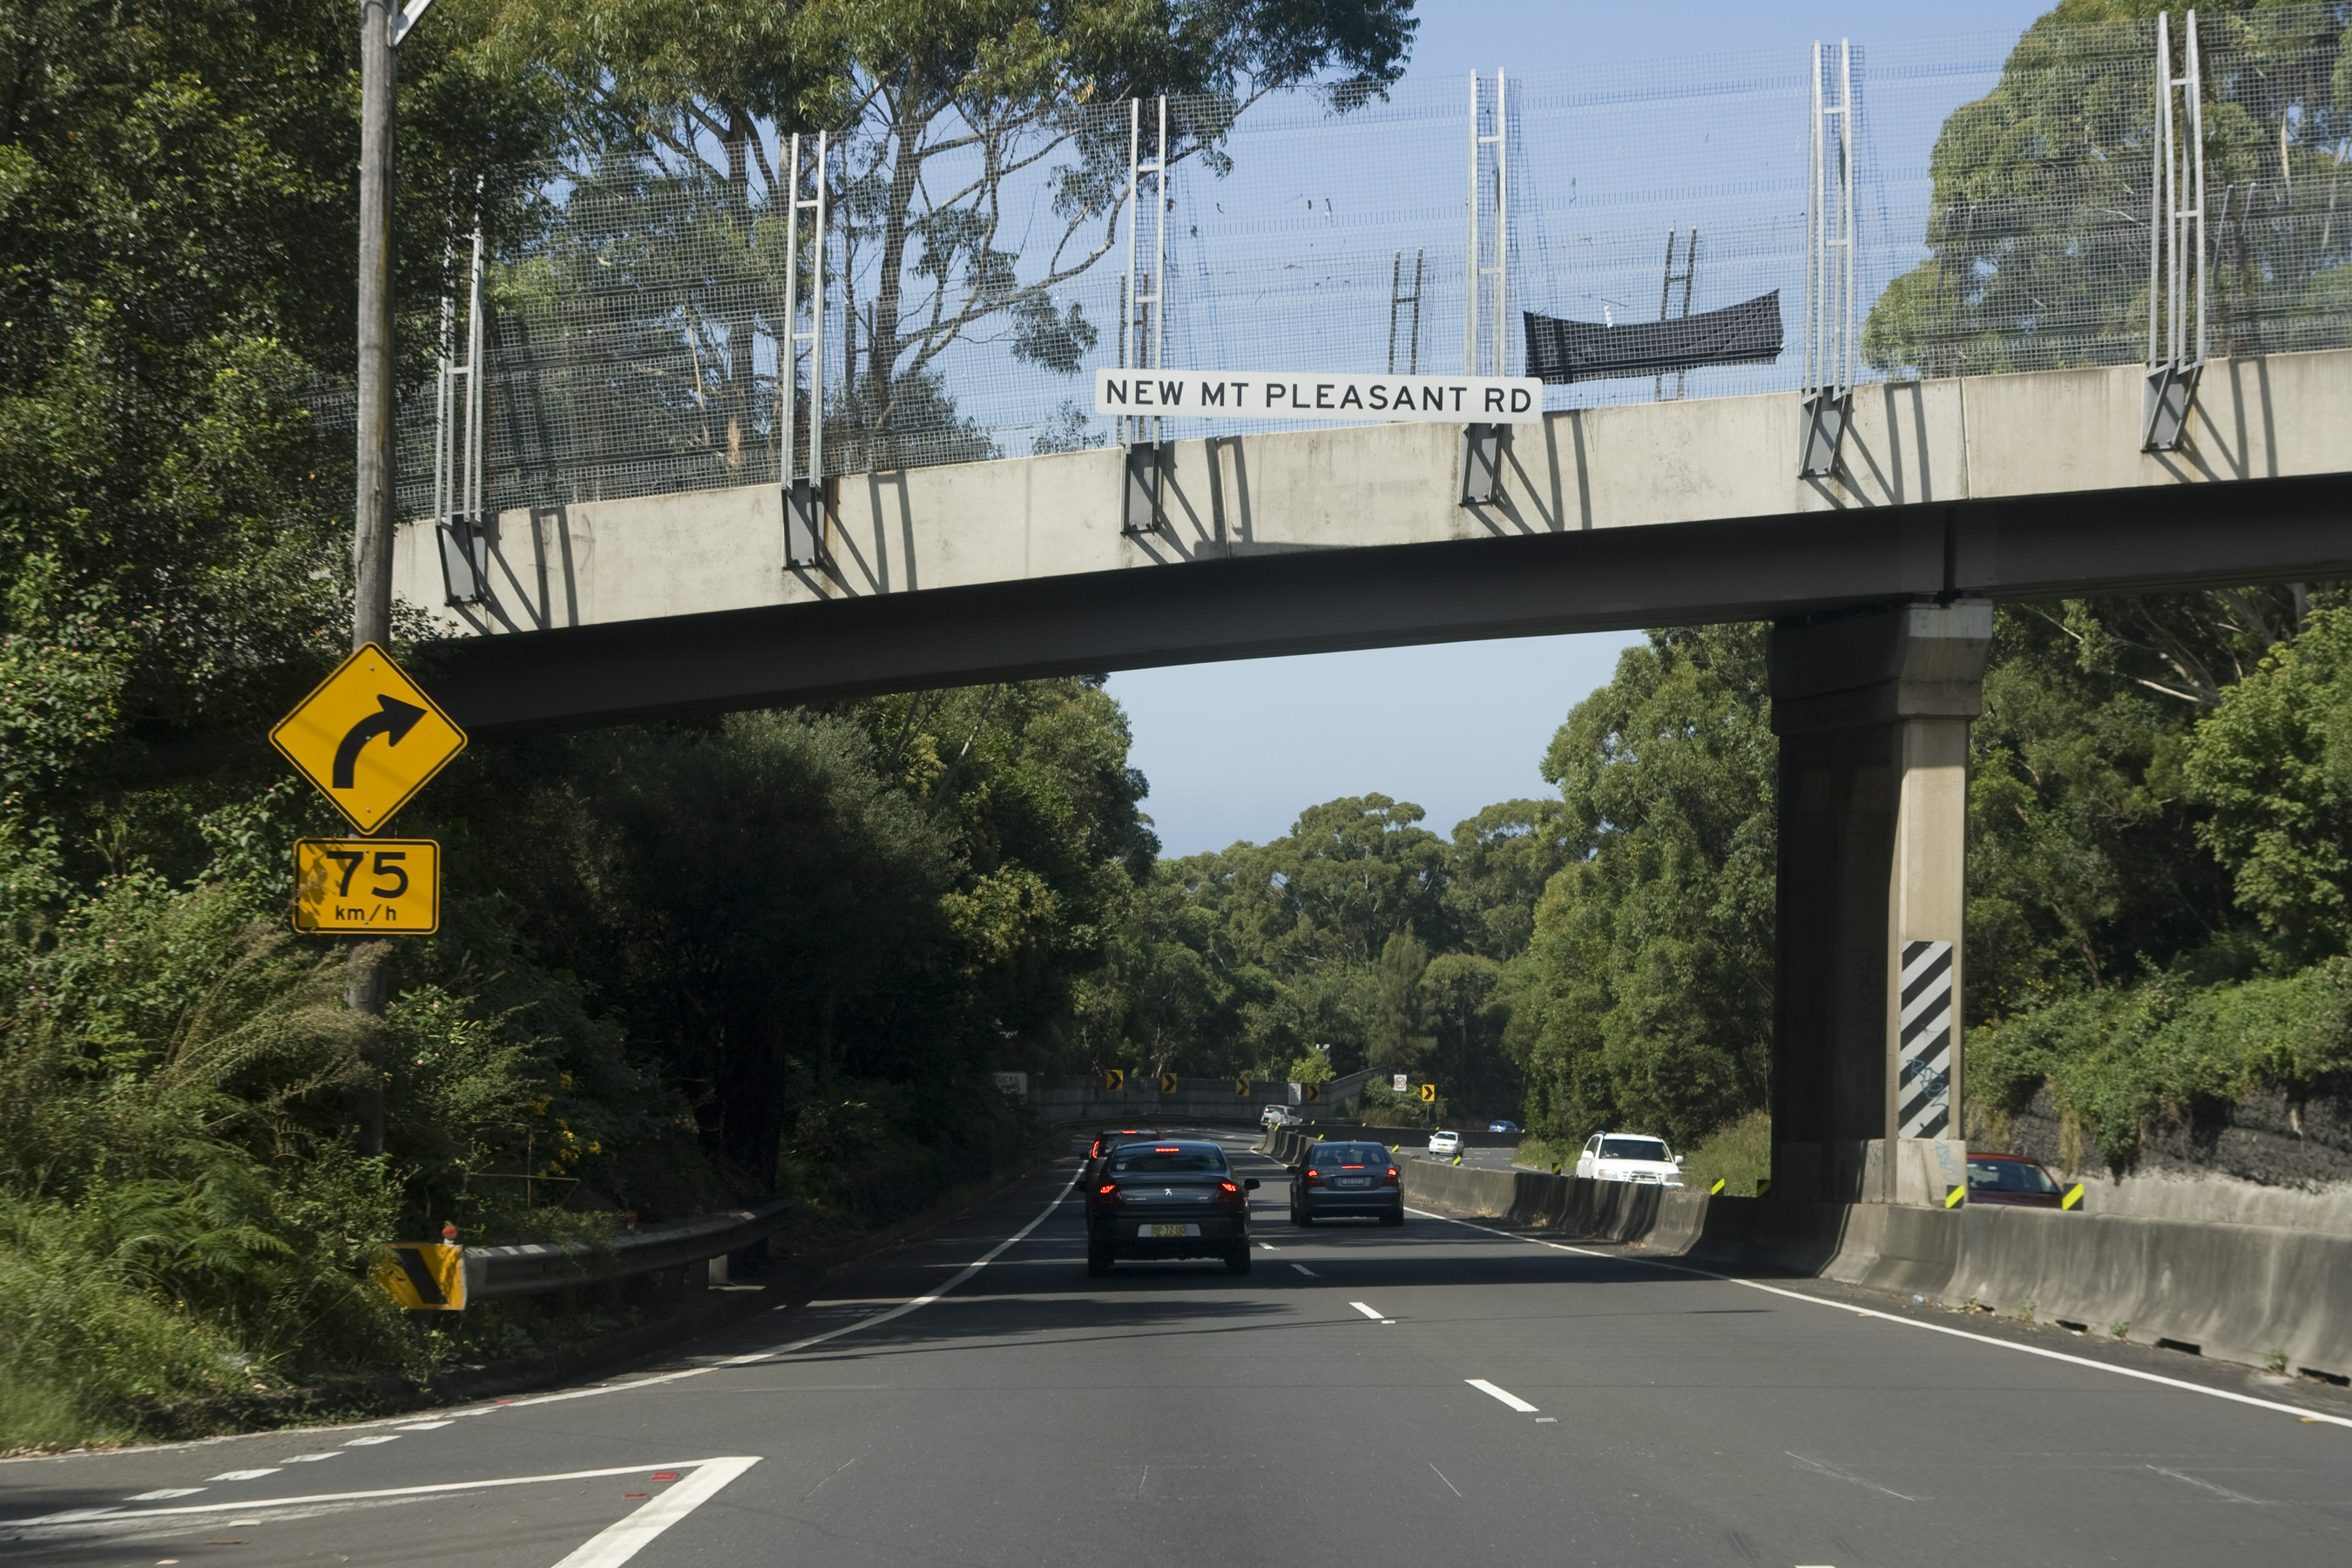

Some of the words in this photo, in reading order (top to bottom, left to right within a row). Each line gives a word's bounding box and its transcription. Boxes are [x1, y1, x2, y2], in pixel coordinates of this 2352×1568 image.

[1106, 380, 1184, 406] NEW
[1202, 382, 1249, 407] MT
[1266, 383, 1468, 412] PLEASANT
[1485, 388, 1531, 413] RD
[326, 850, 409, 899] 75
[335, 904, 396, 922] km/h
